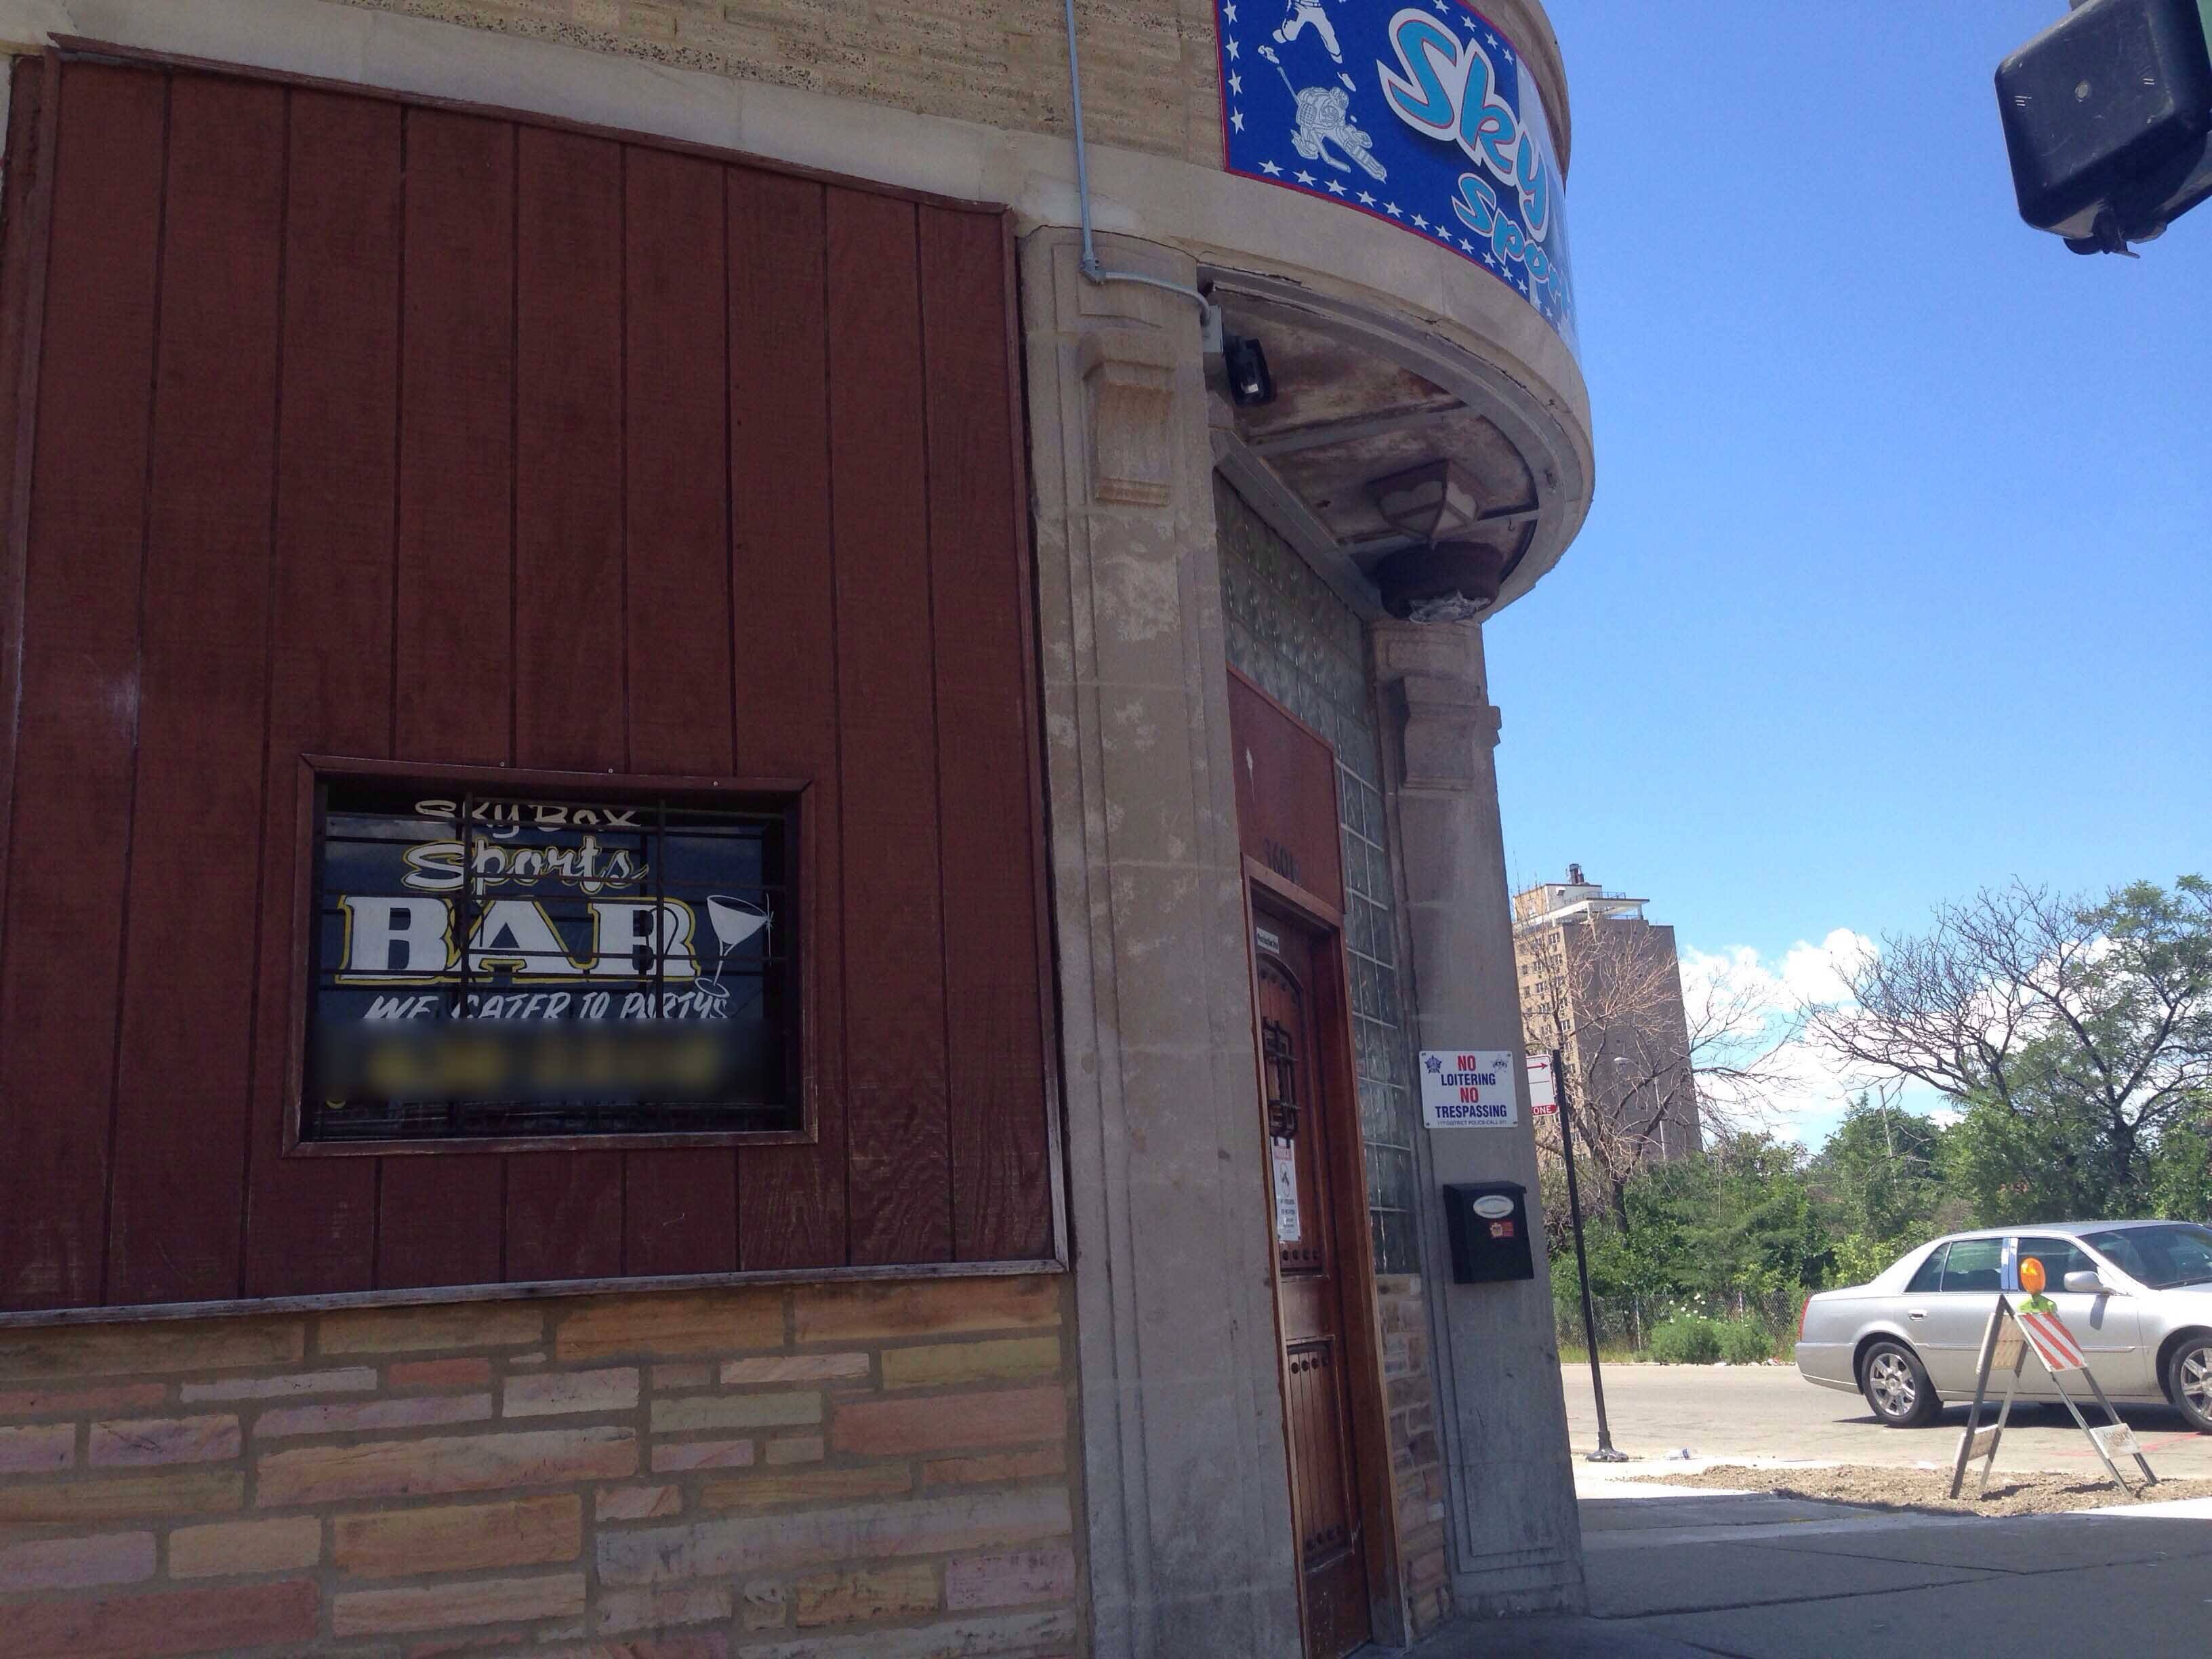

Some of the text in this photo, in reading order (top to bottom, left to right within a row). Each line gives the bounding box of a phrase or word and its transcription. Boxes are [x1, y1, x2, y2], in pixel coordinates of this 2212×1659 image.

[401, 835, 649, 896] Sports
[335, 895, 700, 983] BAR
[579, 991, 609, 1019] TO
[1457, 1054, 1476, 1071] NO
[1441, 1073, 1496, 1086] LOITERING
[1460, 1087, 1479, 1103] NO
[1435, 1105, 1507, 1118] TRESPASSING
